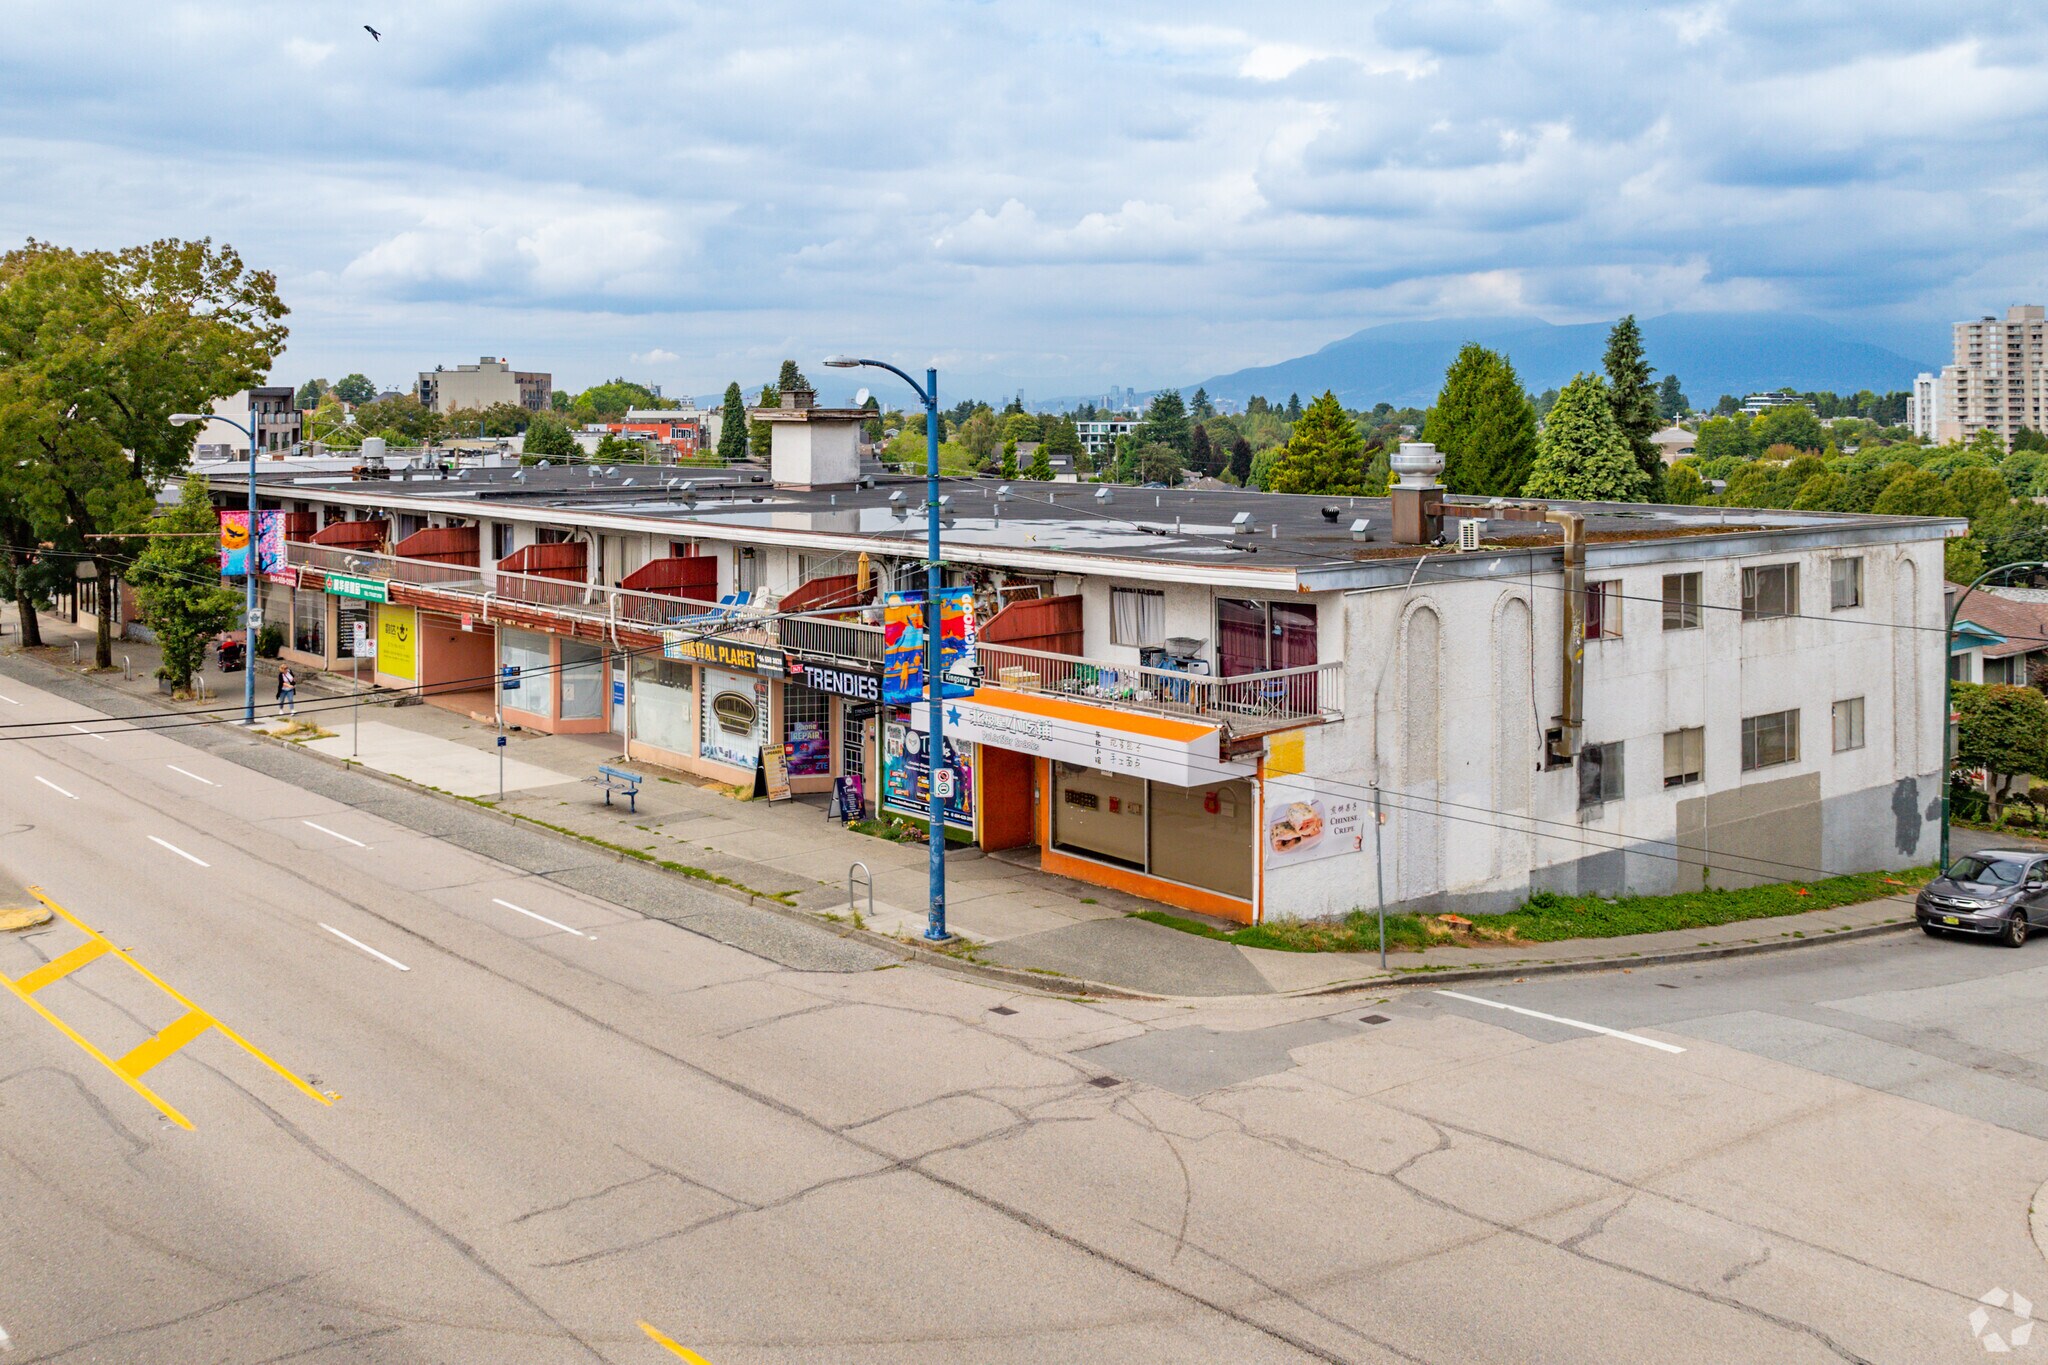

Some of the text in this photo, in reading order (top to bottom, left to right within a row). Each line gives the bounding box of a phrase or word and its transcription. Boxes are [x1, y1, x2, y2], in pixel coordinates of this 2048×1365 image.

[961, 593, 976, 691] INGWOOD
[681, 640, 717, 662] DIGITAL
[719, 646, 756, 668] PLANET
[805, 666, 879, 701] TRENDIES
[945, 673, 971, 687] Kingsway
[793, 731, 820, 740] REPAIR
[816, 762, 828, 770] ZTE
